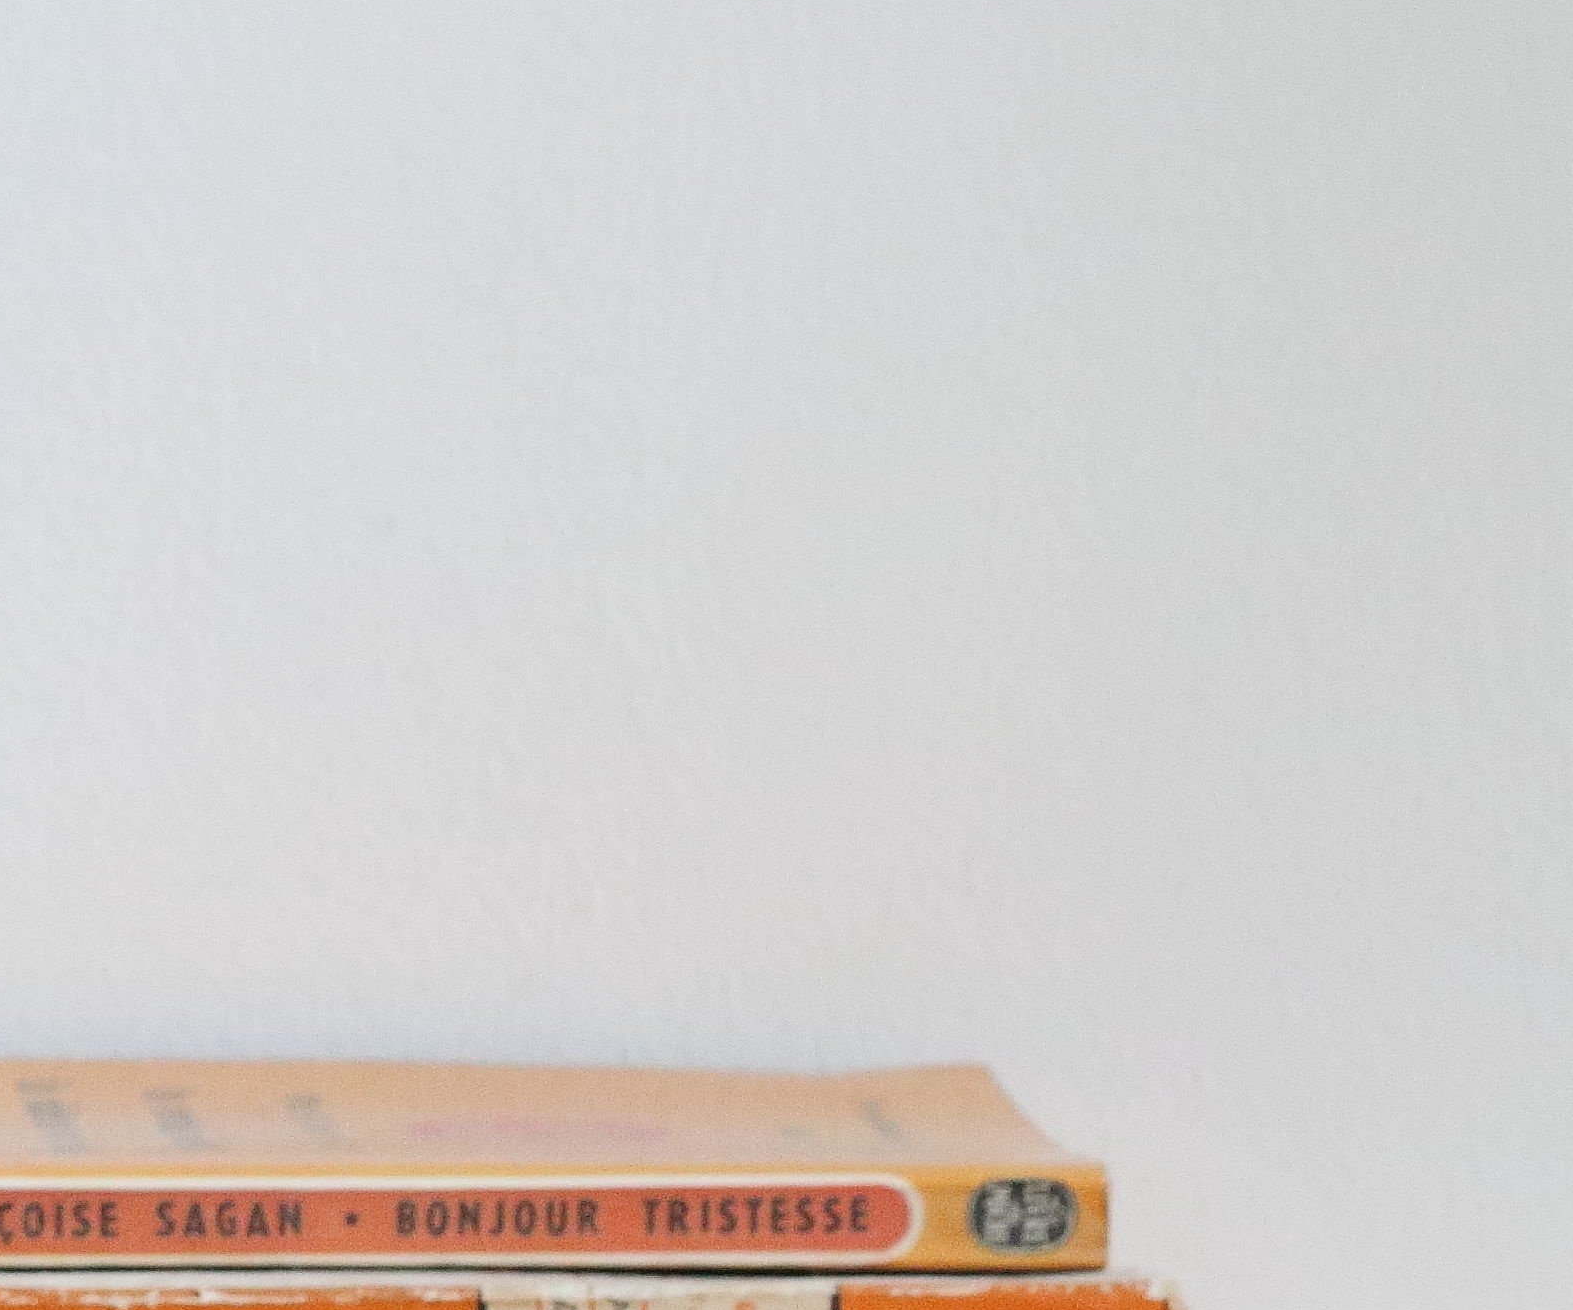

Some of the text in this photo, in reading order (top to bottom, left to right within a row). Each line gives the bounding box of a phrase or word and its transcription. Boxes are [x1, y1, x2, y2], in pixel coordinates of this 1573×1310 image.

[155, 1201, 303, 1238] SAGAN
[395, 1199, 600, 1235] BONJOUR
[643, 1198, 870, 1234] TRISTESSE
